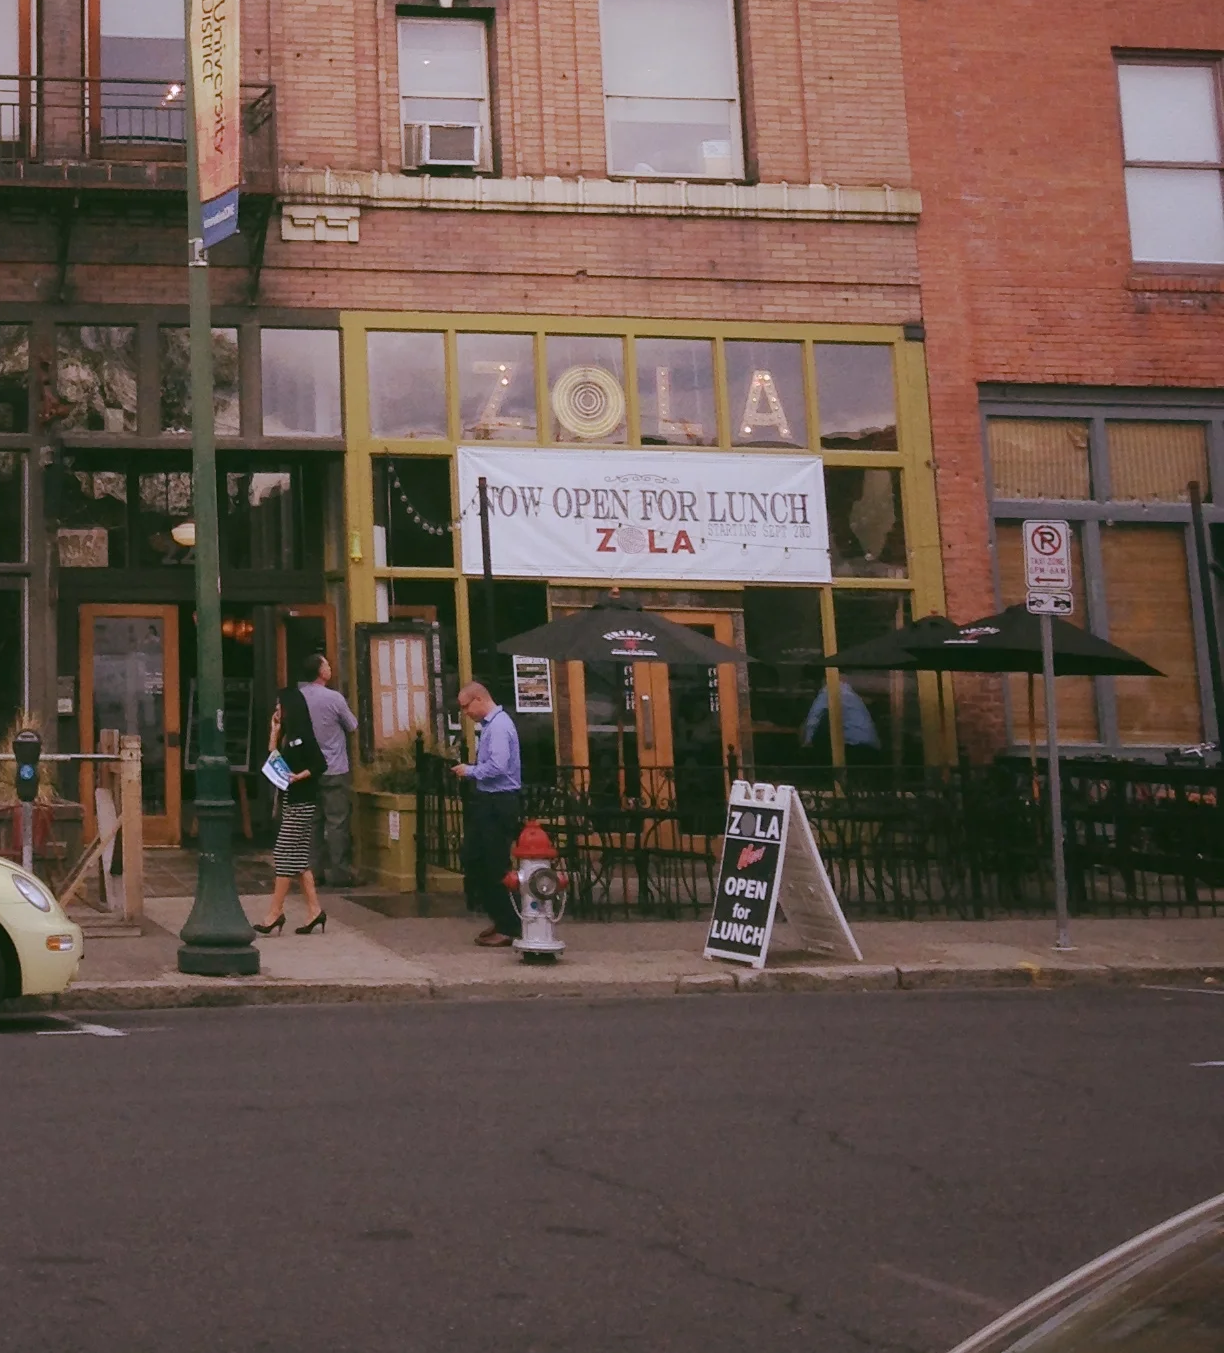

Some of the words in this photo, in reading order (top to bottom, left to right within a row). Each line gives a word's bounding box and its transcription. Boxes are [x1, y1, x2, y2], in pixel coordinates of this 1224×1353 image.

[213, 0, 227, 155] University
[552, 486, 630, 520] OPEN
[640, 489, 700, 522] FOR
[706, 491, 811, 525] LUNCH
[707, 523, 757, 538] STARTING
[762, 524, 787, 539] SEPT
[793, 525, 812, 539] 2ND
[725, 876, 768, 900] OPEN
[732, 902, 752, 920] for
[711, 919, 766, 946] LUNCH
